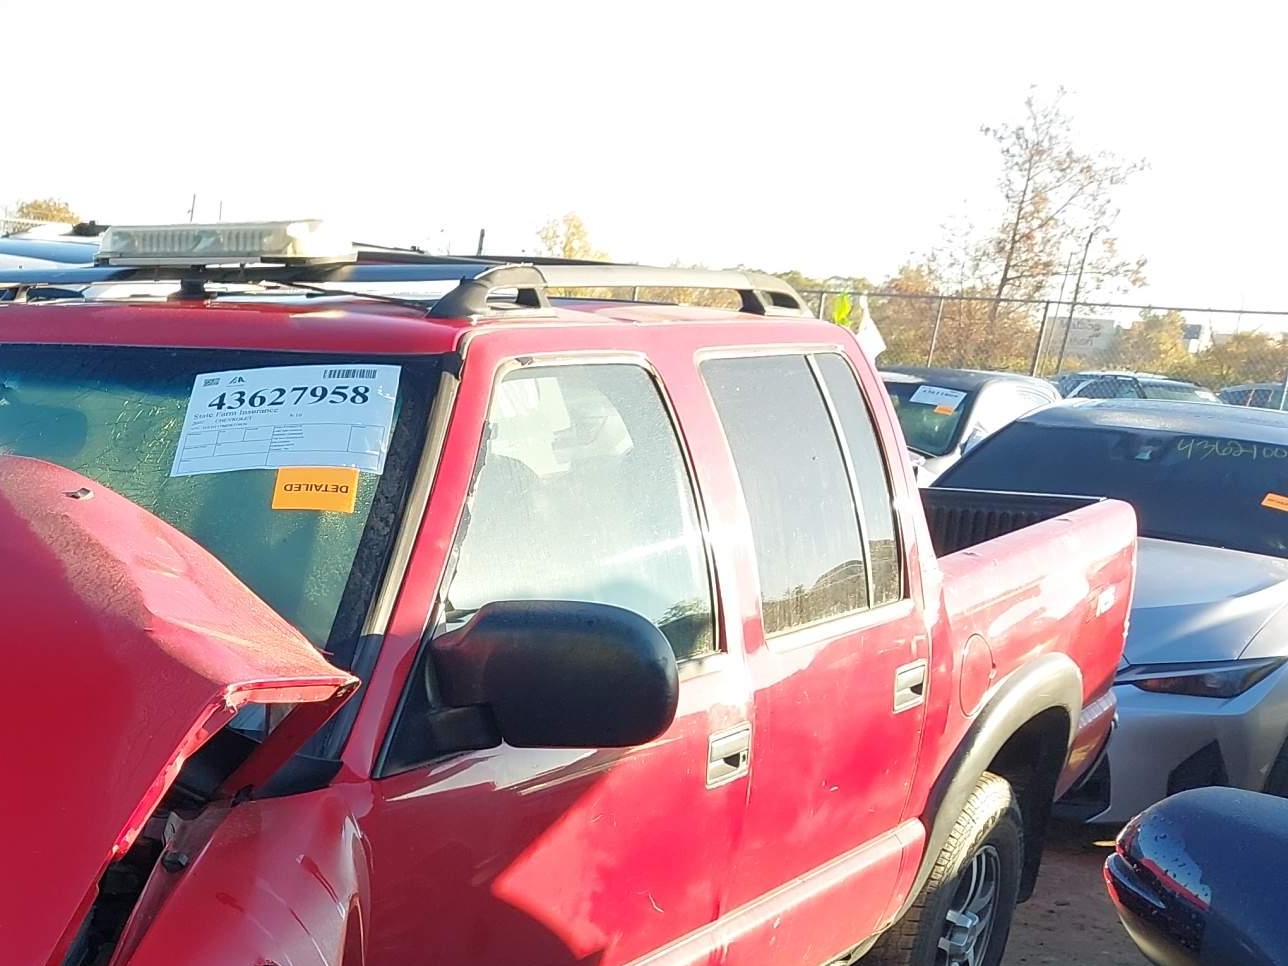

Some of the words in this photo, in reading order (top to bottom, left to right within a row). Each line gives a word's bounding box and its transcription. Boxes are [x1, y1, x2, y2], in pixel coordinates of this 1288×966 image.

[208, 385, 370, 410] 43627958
[193, 411, 214, 420] State
[215, 410, 237, 418] Farm
[239, 408, 279, 416] Insurance
[283, 483, 349, 494] DETAILED
